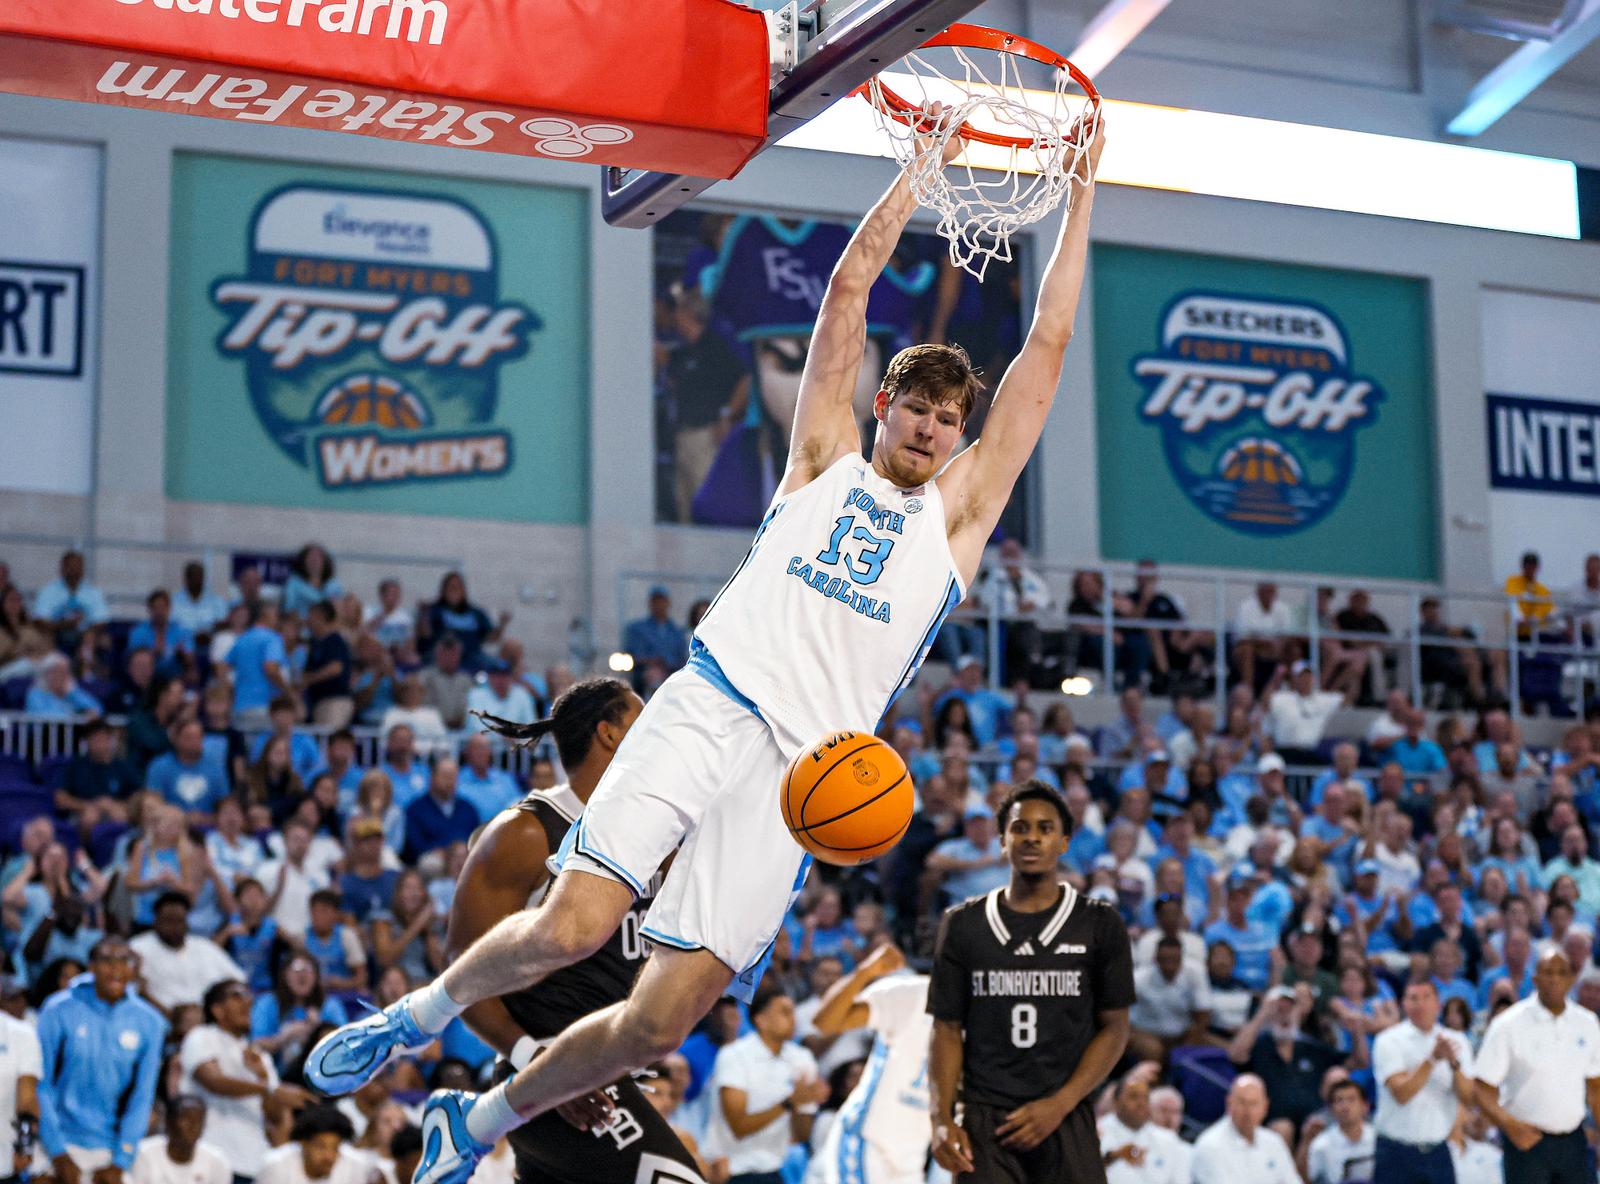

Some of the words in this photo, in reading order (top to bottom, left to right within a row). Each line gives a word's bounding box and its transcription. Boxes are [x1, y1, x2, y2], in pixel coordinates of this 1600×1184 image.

[115, 0, 448, 45] eFarm
[95, 61, 516, 146] StateFarm
[275, 258, 353, 287] FORT
[367, 267, 470, 297] MYERS
[0, 280, 67, 358] RT
[216, 282, 524, 368] Tip-Off
[1184, 306, 1325, 339] SKECHERS
[1180, 336, 1241, 360] FORT
[1251, 346, 1332, 372] MYERS
[1134, 359, 1374, 432] Tip-Off
[1496, 406, 1600, 483] INTE
[843, 487, 906, 535] NORTH
[816, 515, 895, 585] 13
[786, 556, 891, 624] CAROLINA
[988, 970, 1082, 996] BONAVENTURE
[1012, 1003, 1037, 1048] 8
